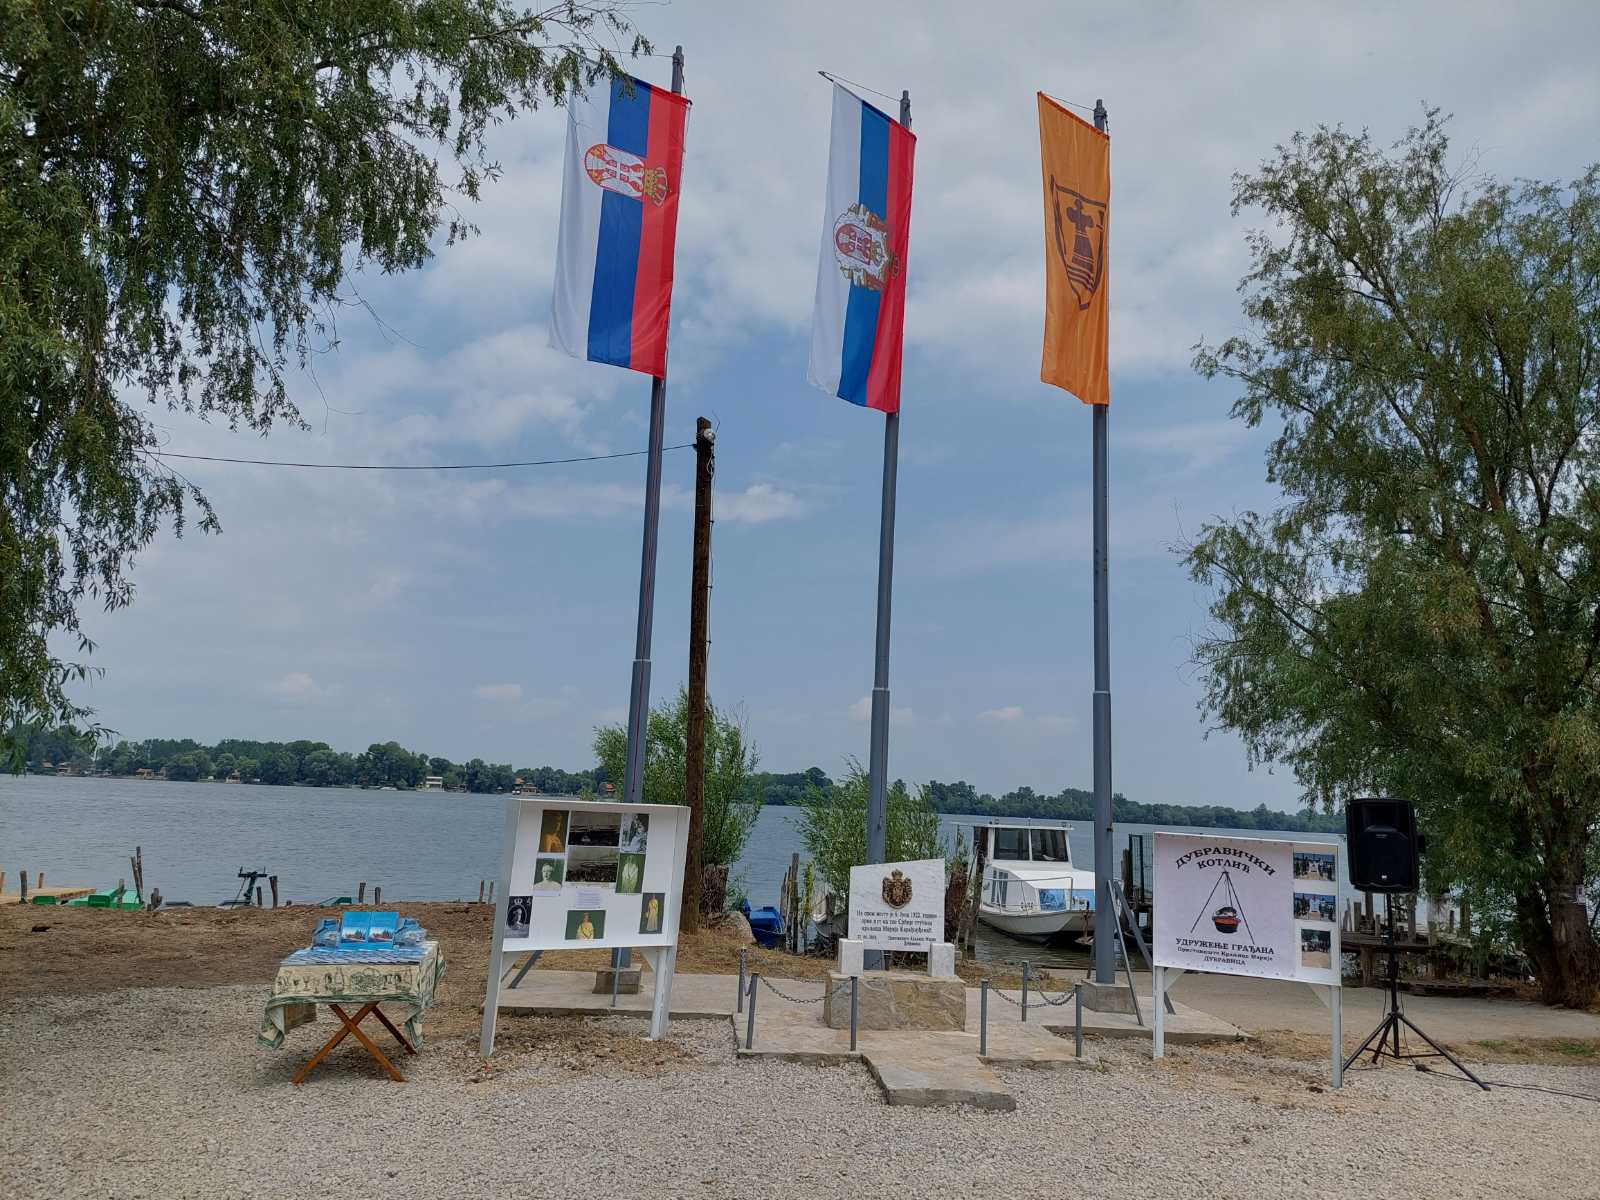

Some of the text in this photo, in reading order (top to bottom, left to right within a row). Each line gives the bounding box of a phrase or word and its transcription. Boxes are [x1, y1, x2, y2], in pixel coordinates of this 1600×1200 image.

[1175, 847, 1276, 876] ДУБРАВИЧКИ
[1196, 858, 1250, 874] КОТЛИЋ
[1175, 937, 1275, 954] УДРУЖЕЊЕ ГРАЂАНА
